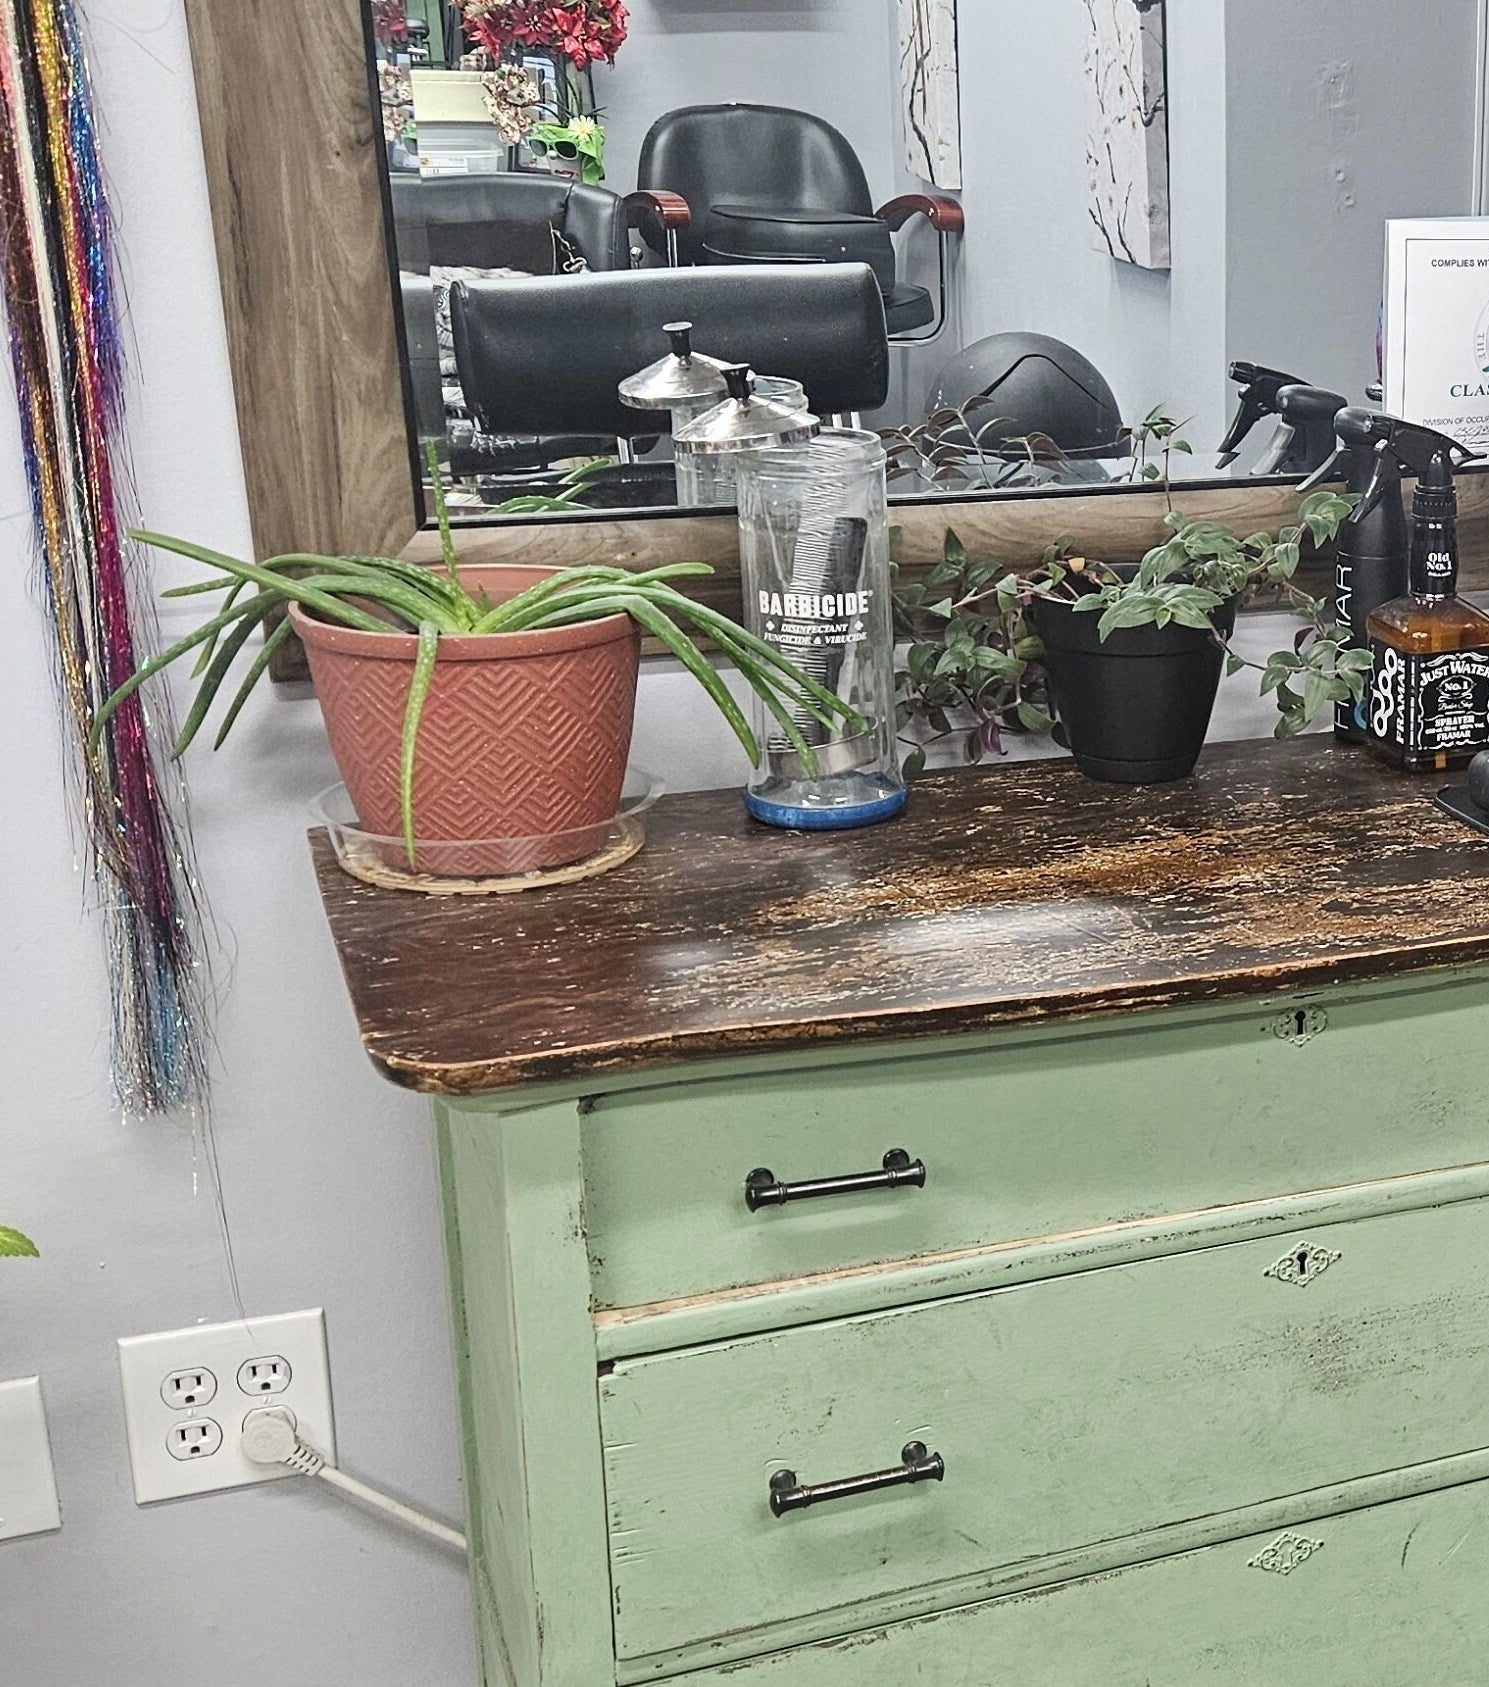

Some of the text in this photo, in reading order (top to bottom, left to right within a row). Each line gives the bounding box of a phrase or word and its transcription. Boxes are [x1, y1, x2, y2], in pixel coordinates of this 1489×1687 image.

[1431, 259, 1475, 268] COMPLIES
[759, 590, 869, 618] BARBICIDE
[780, 623, 849, 634] DISINFECTANT
[764, 632, 812, 645] FUNGICIDE
[824, 632, 868, 645] VIRUCIDE
[1420, 665, 1450, 687] JUST
[1396, 658, 1406, 745] FRAMAR
[1434, 715, 1475, 728] SPRAYER
[1436, 729, 1472, 742] FRAMAR
